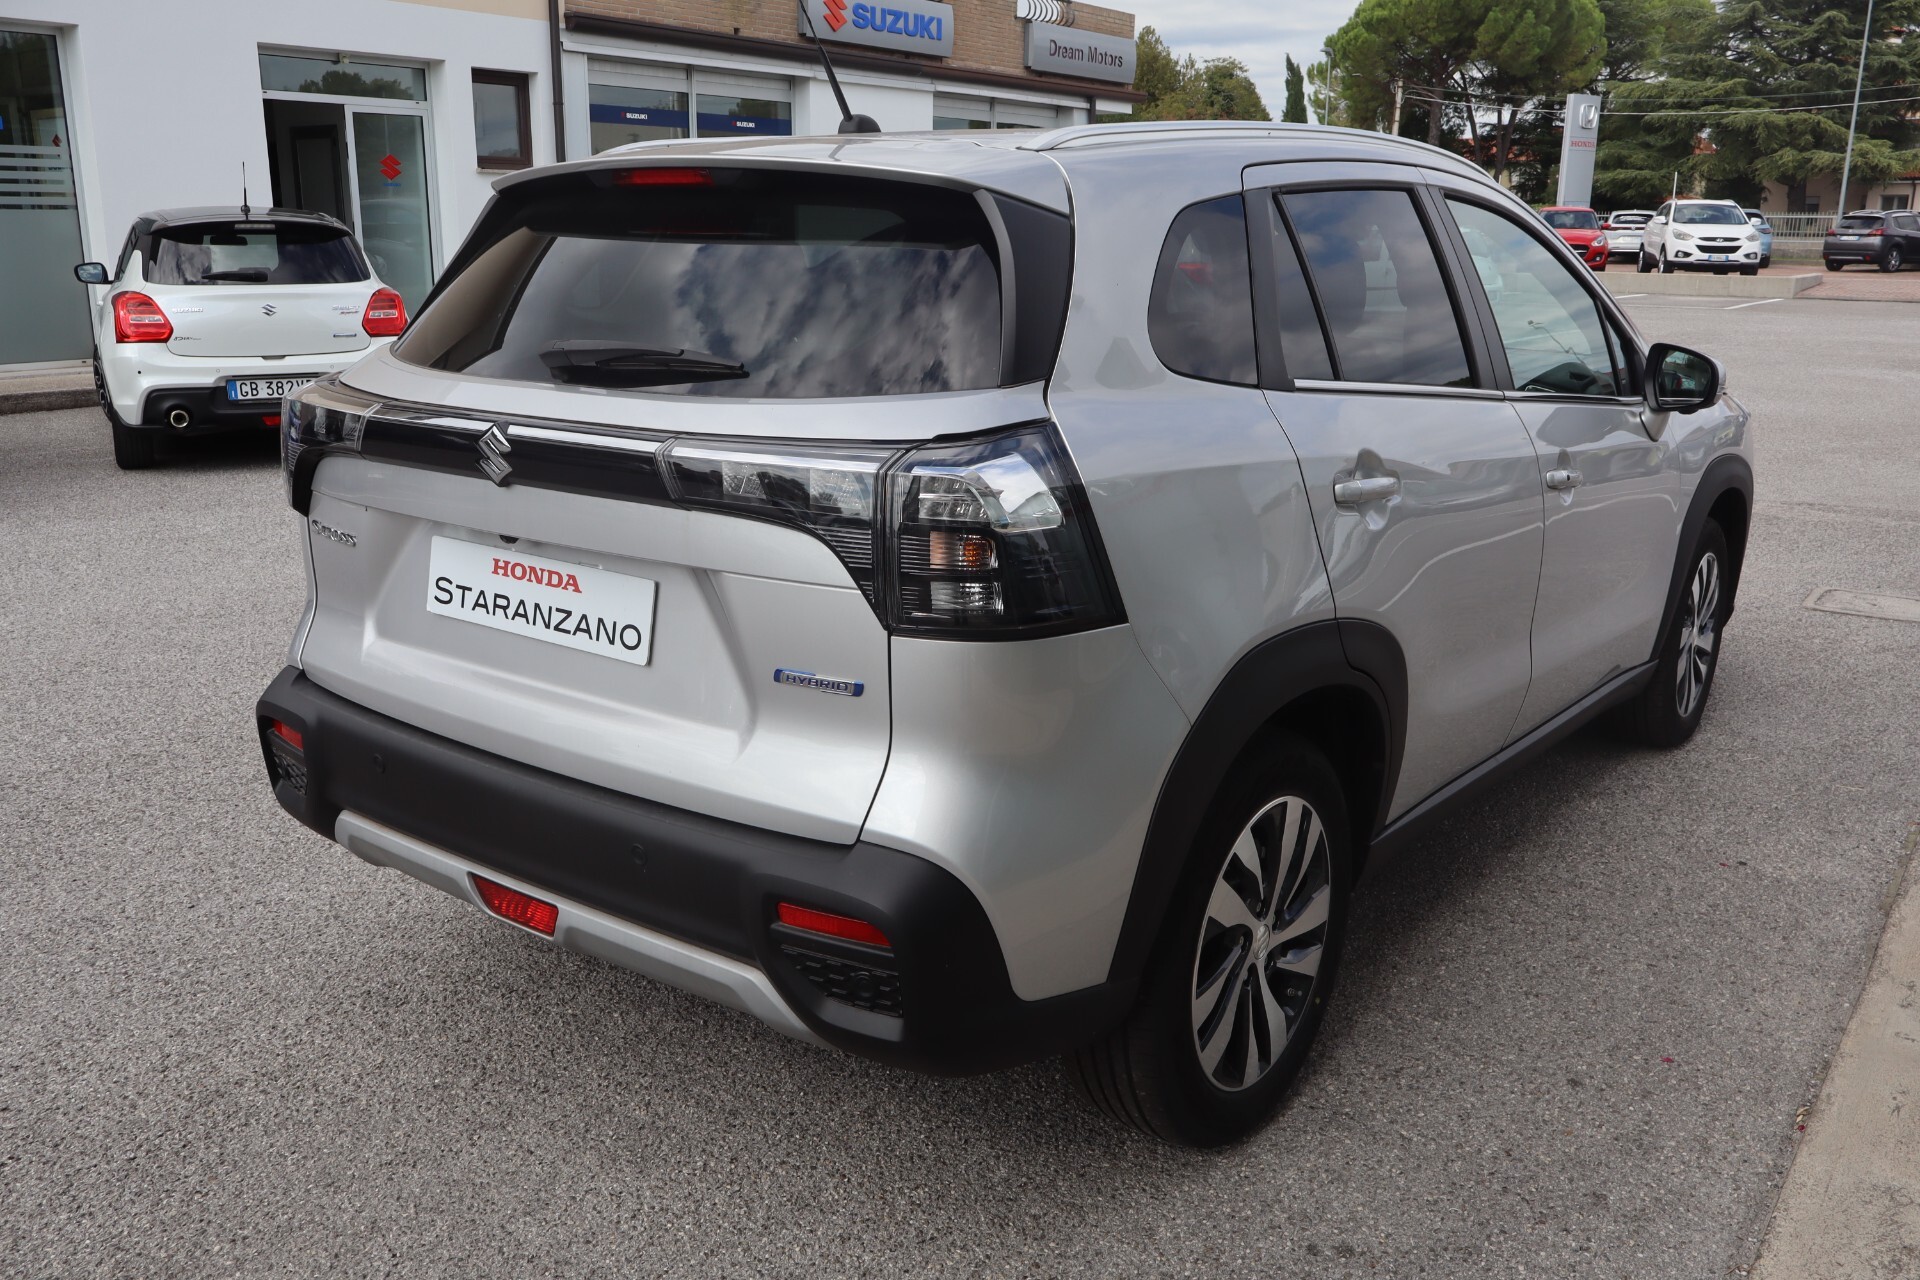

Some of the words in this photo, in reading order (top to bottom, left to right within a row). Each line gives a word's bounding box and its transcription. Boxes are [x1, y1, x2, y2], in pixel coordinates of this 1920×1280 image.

[852, 3, 942, 41] SUZUKI
[1049, 39, 1084, 62] Dream
[1088, 46, 1123, 68] Motors
[626, 112, 648, 120] SUZUKI
[1571, 140, 1596, 148] HONDA
[240, 381, 259, 397] GB
[491, 558, 582, 594] HONDA
[786, 674, 849, 692] HYBRID
